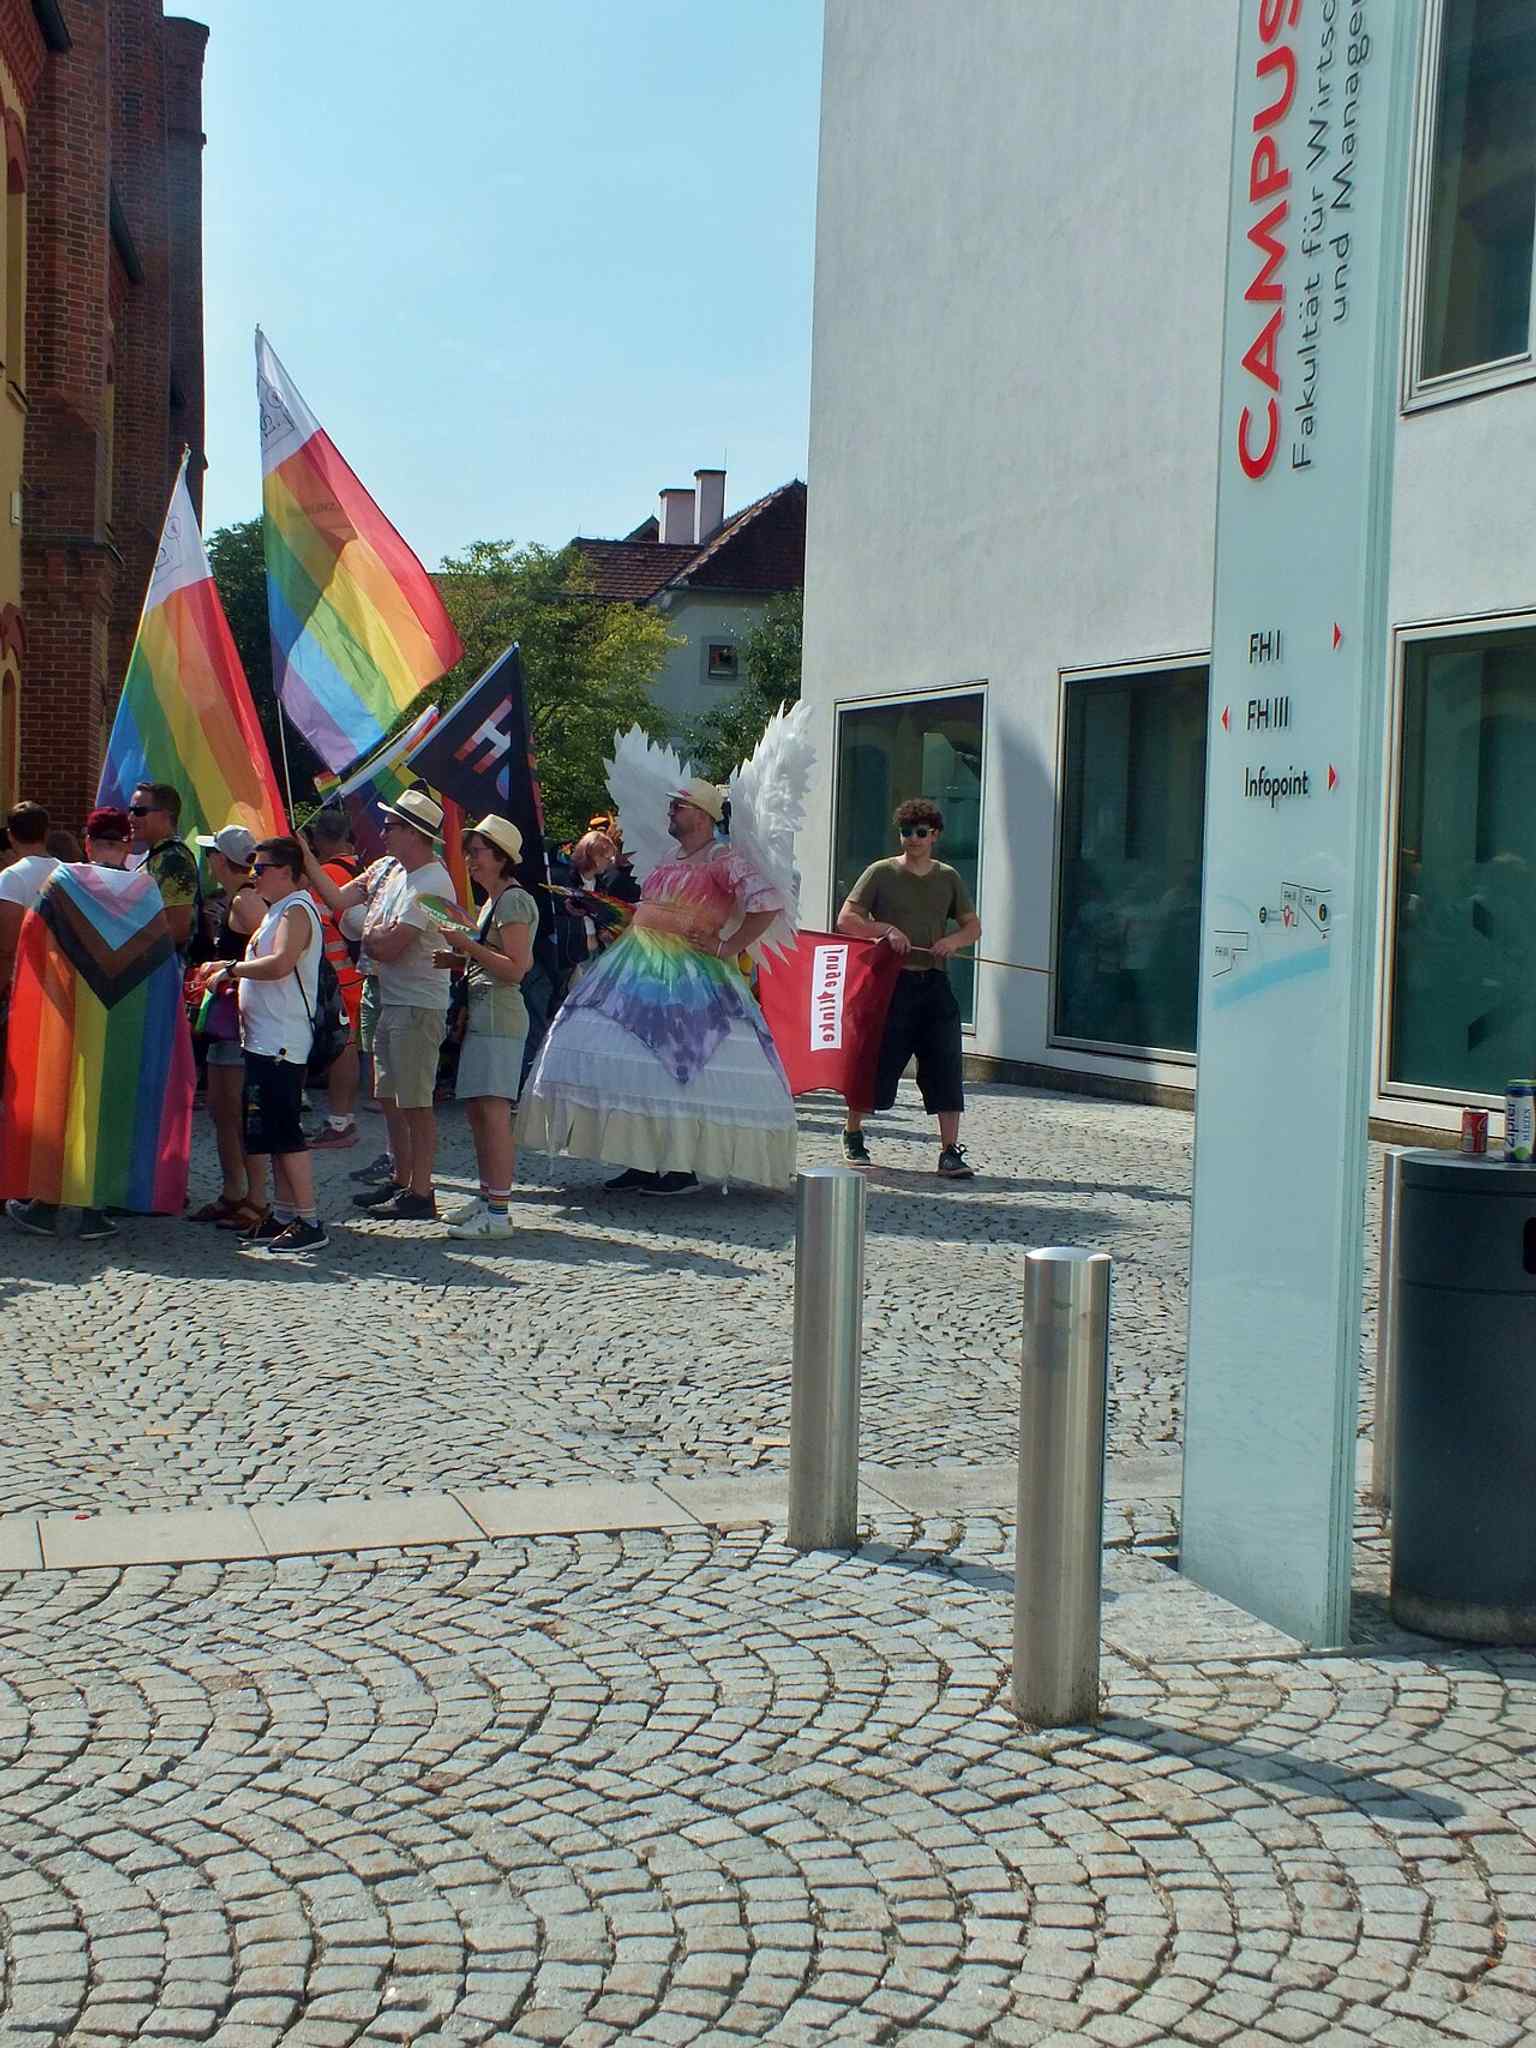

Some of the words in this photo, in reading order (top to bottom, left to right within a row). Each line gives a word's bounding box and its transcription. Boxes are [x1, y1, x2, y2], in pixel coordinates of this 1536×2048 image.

[1330, 0, 1370, 209] Manage
[1238, 0, 1302, 480] CAMPUS
[1301, 185, 1325, 257] für
[1329, 233, 1350, 322] und
[1292, 273, 1320, 470] Fakultät
[1249, 631, 1271, 664] FH
[1275, 629, 1281, 660] I
[1247, 699, 1270, 731] FH
[1273, 696, 1290, 729] III
[1244, 766, 1309, 808] Infopoint
